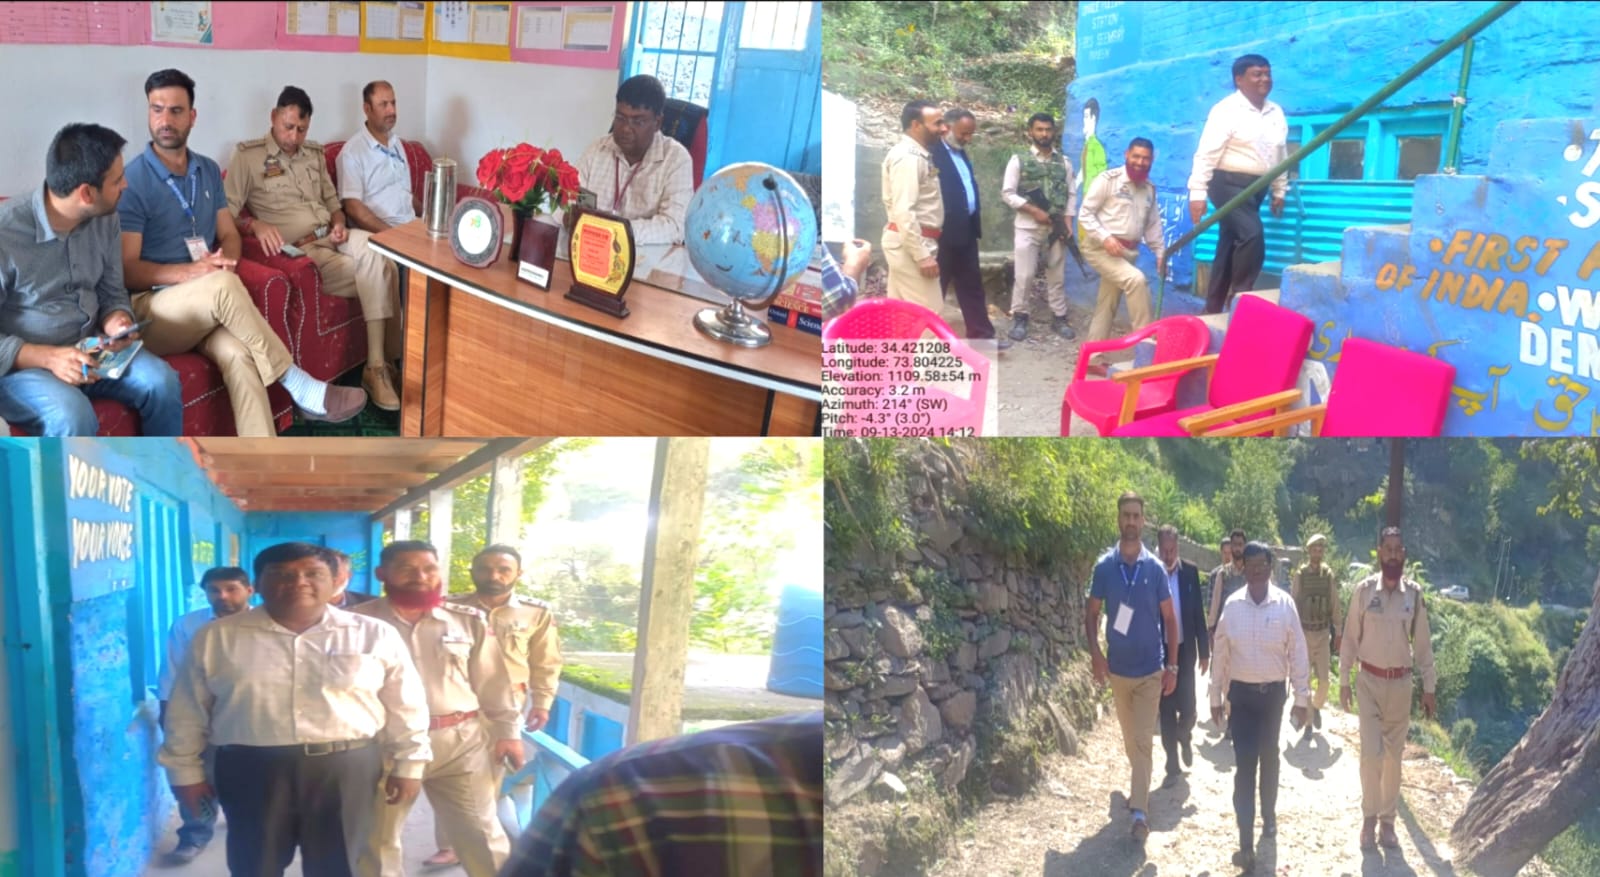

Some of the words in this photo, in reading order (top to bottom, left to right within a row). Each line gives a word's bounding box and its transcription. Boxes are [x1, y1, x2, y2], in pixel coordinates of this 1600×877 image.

[1442, 230, 1569, 275] FIRST
[1375, 263, 1417, 291] OF
[69, 454, 106, 503] YOUR
[108, 474, 134, 512] VOTE
[72, 518, 106, 569] YOUR
